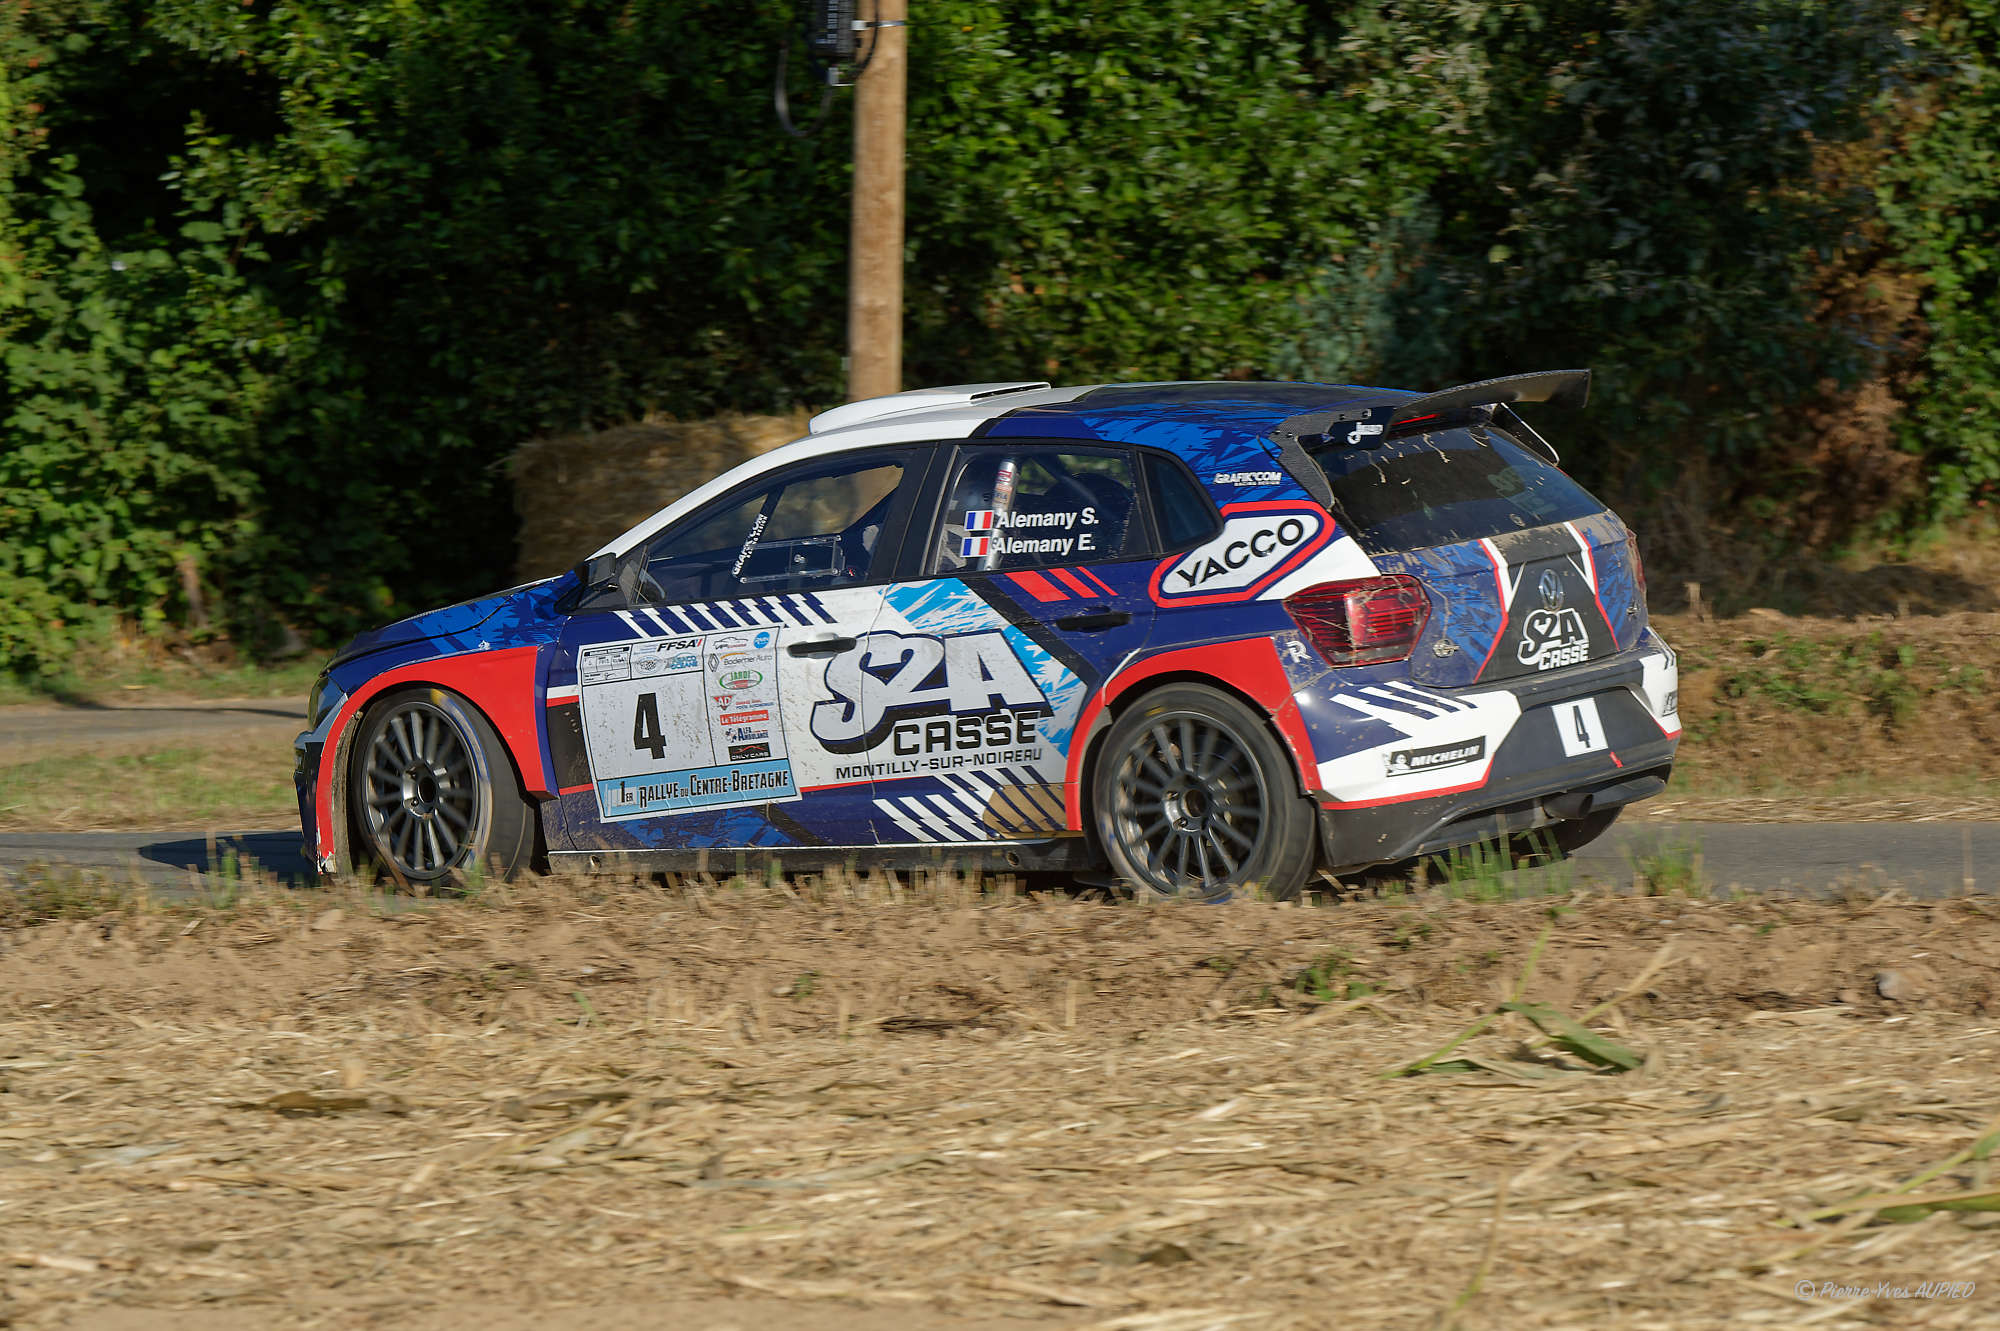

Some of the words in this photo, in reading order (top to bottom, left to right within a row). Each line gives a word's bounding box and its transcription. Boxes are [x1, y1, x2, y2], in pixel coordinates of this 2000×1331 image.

[995, 511, 1077, 530] Alemany
[1081, 507, 1099, 525] S.
[993, 537, 1074, 556] Alemany
[1077, 533, 1096, 551] E.
[1176, 519, 1304, 588] YACCO
[656, 639, 696, 653] FFSA
[1517, 608, 1589, 665] S2A
[1538, 644, 1590, 671] CASSE
[810, 629, 1054, 754] S2A
[633, 692, 667, 760] 4
[893, 711, 1040, 756] CASSE
[1572, 705, 1591, 748] 4
[836, 748, 1042, 780] MONTILLY-SUR-NOIREAU
[1410, 745, 1481, 767] MICHELIN
[638, 781, 679, 809] RALLYE
[690, 769, 789, 797] CENTRE-BRETAGNE
